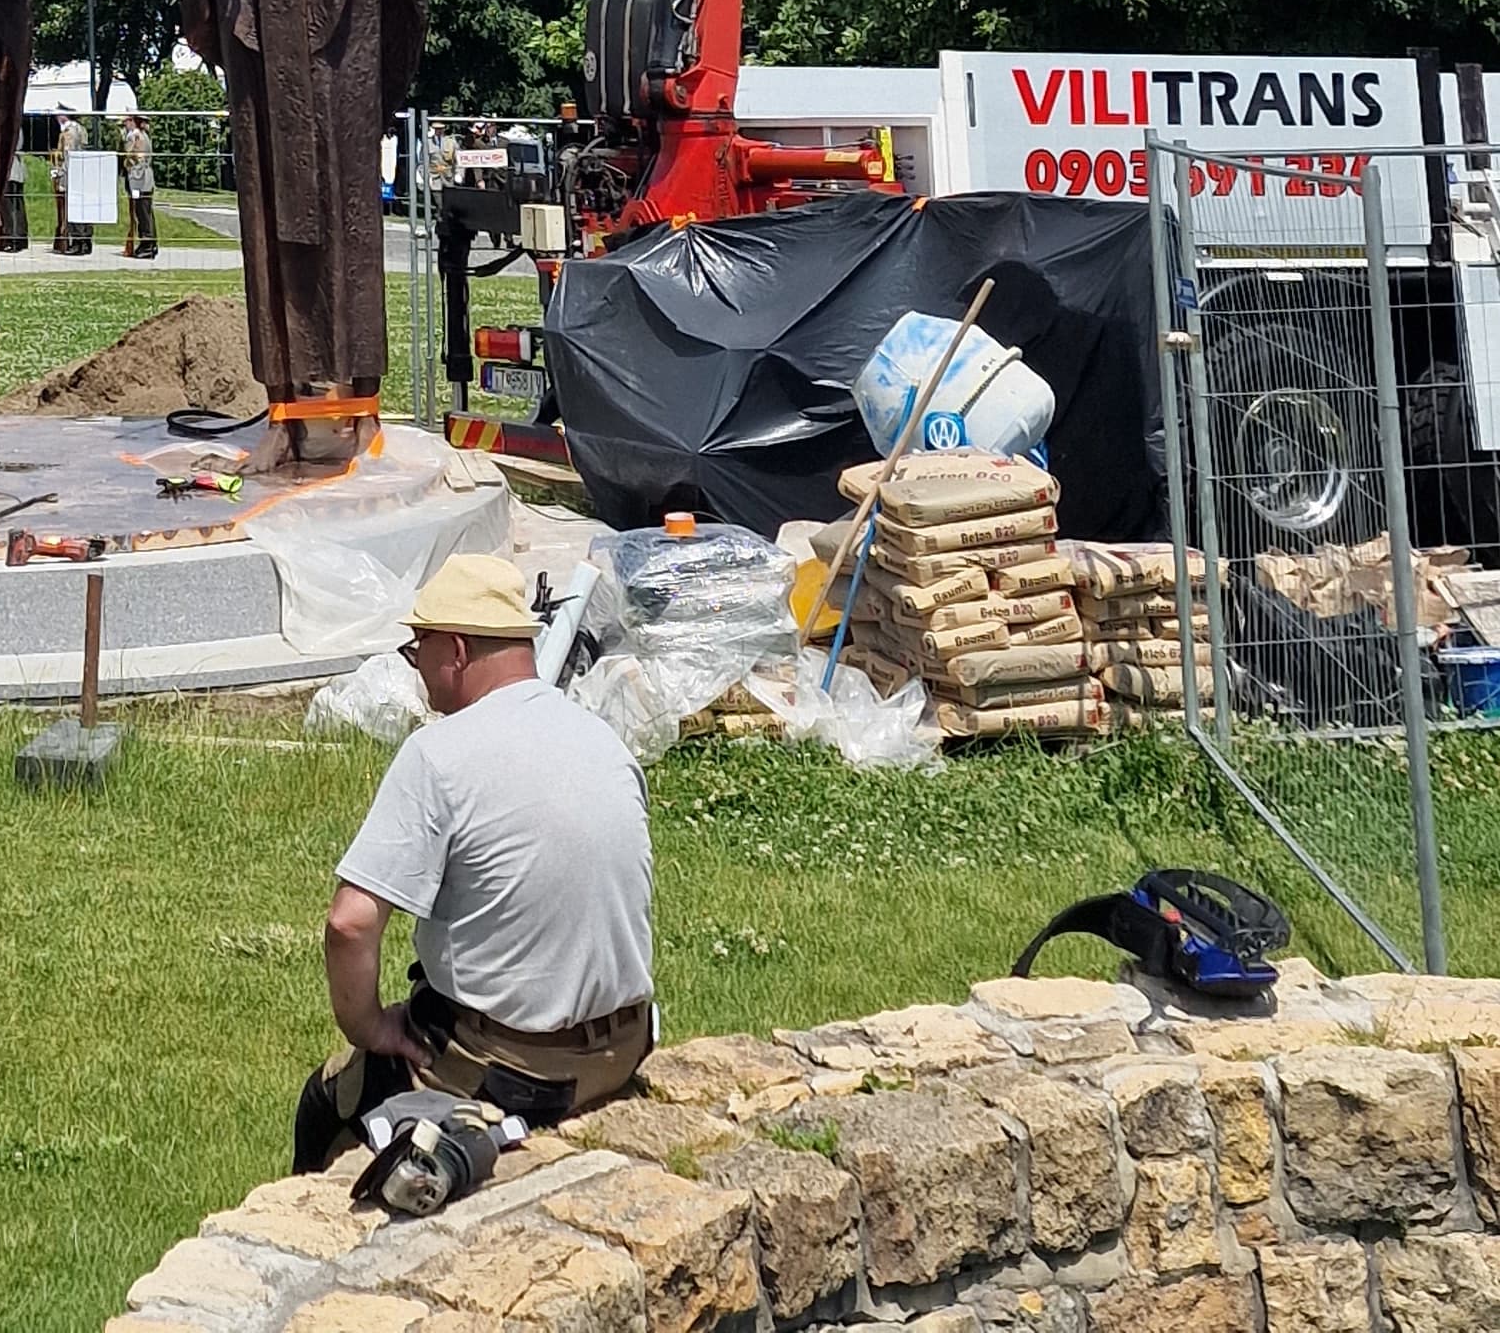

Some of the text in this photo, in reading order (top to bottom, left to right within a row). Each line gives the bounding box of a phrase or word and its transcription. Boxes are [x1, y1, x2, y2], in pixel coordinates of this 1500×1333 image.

[1012, 69, 1383, 127] VILITRANS
[1025, 149, 1150, 197] 0903
[994, 524, 1016, 539] B20
[932, 579, 973, 603] Baumit
